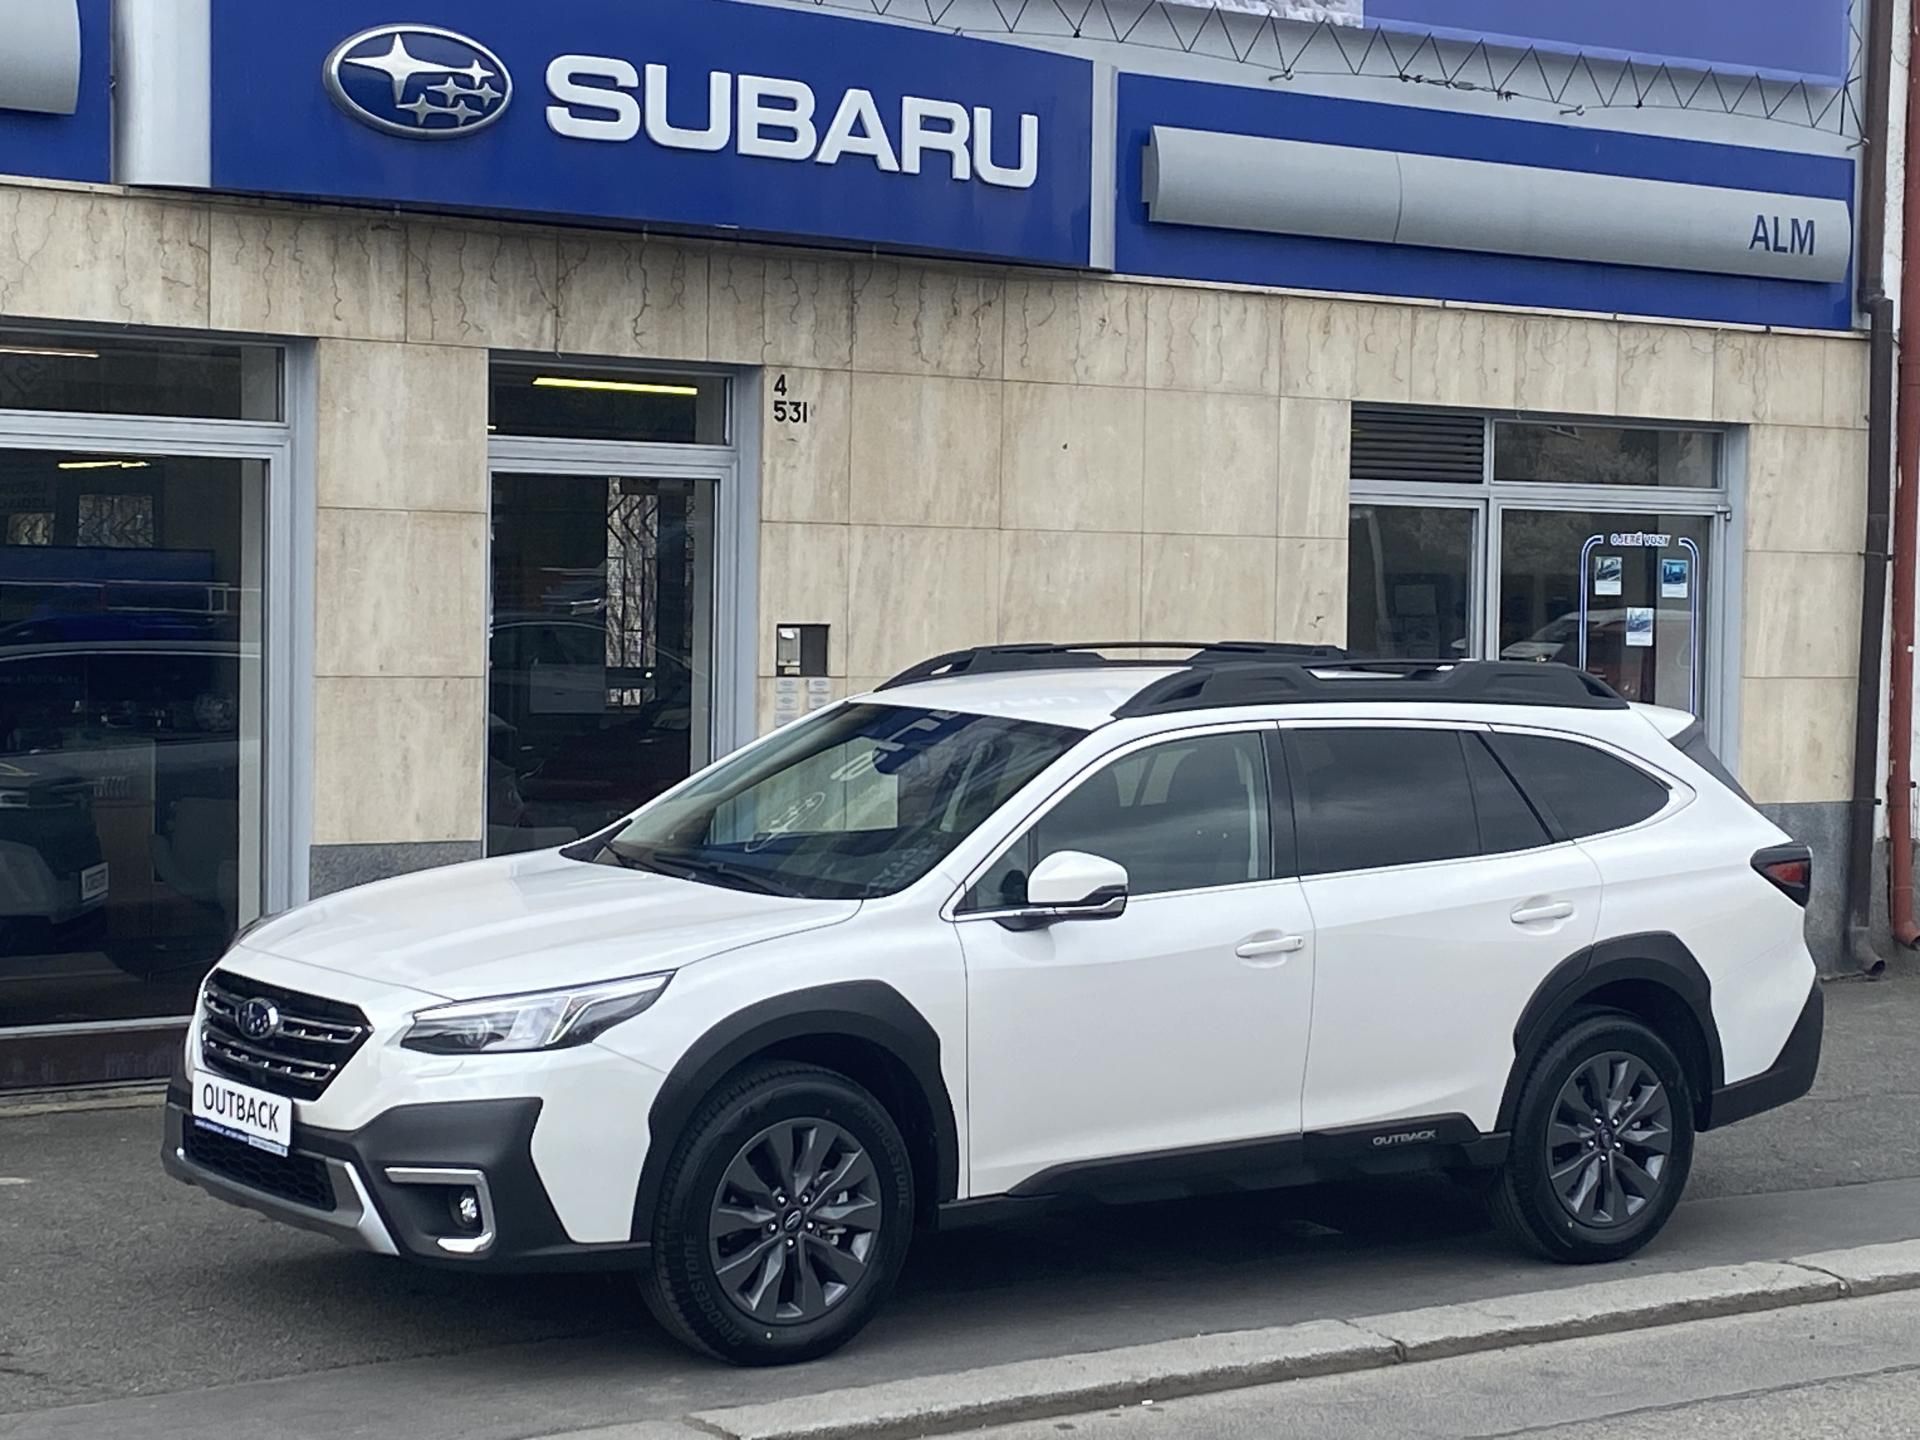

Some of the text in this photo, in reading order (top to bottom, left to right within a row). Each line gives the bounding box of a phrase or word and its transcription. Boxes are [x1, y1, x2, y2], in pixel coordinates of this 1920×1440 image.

[545, 54, 1038, 188] SUBARU
[1749, 215, 1815, 255] ALM
[774, 374, 787, 396] 4
[774, 401, 807, 423] 531
[203, 1083, 280, 1132] OUTBACK
[1372, 1129, 1437, 1146] OUTBACK
